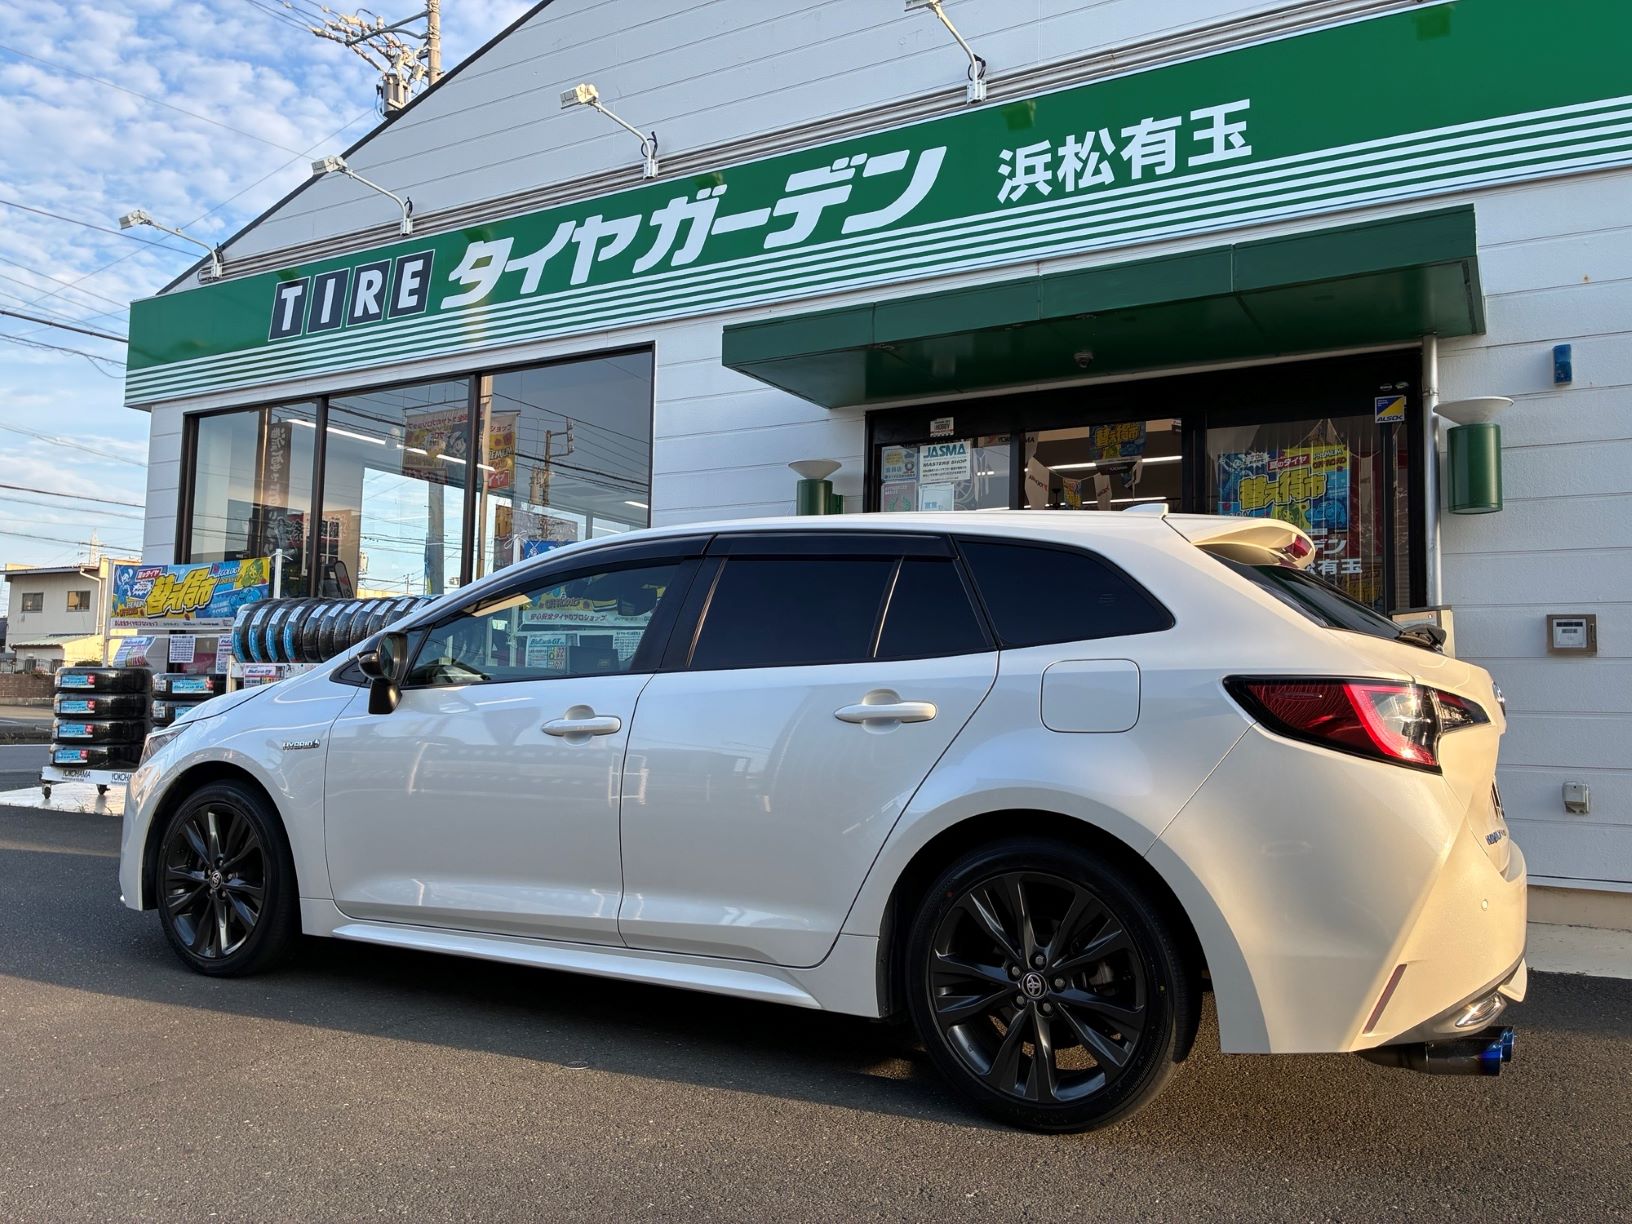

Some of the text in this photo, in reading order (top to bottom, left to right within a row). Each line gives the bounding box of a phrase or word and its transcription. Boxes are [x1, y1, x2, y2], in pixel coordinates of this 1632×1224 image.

[275, 98, 1252, 334] TIRE タイヤガーデン 浜松有玉
[923, 443, 967, 458] JASMA
[1269, 456, 1308, 468] 夏のタイヤ
[1239, 468, 1327, 510] 替え得市
[62, 769, 91, 778] YOKOHAMA
